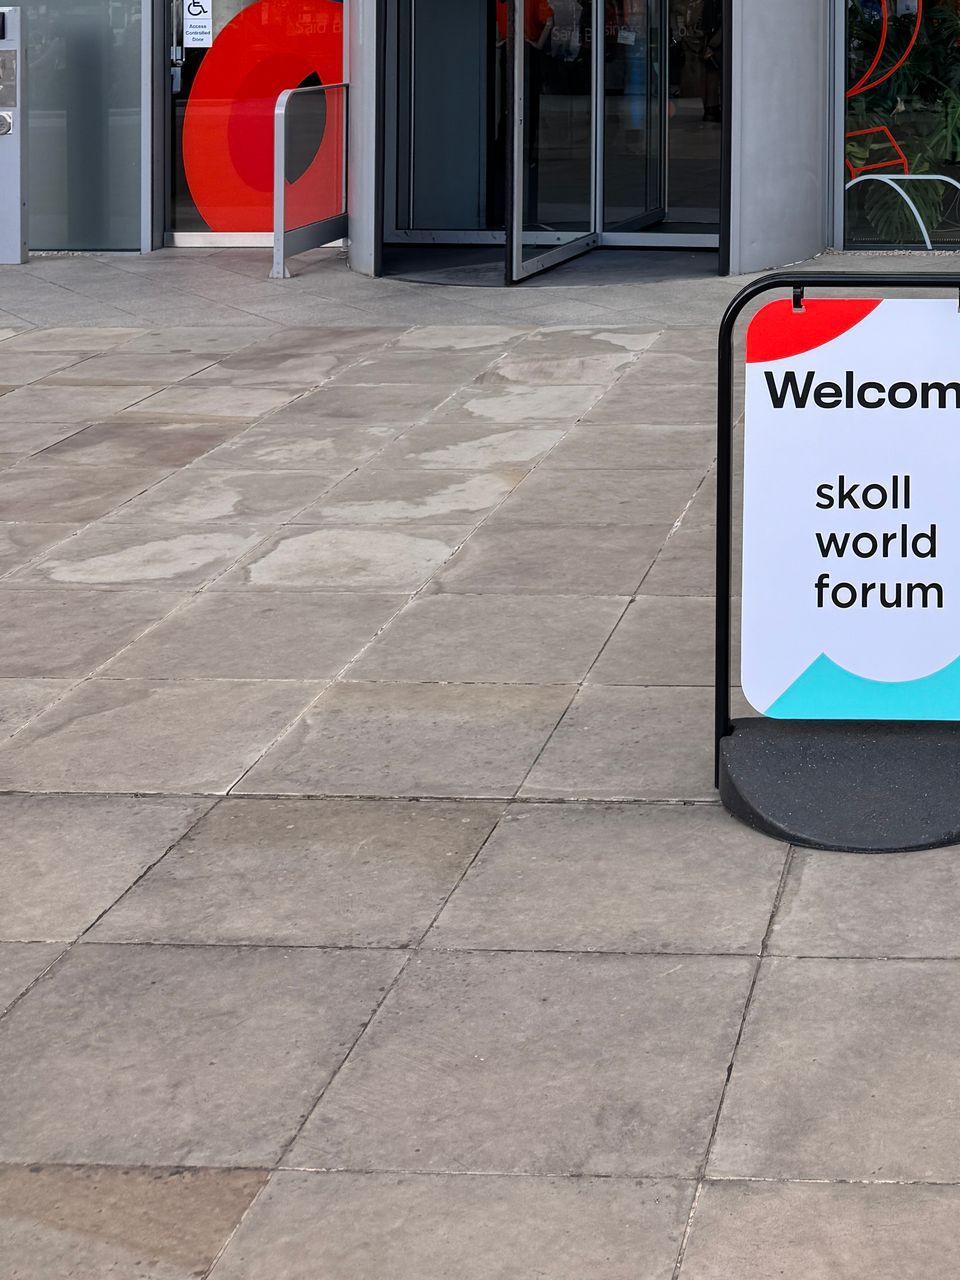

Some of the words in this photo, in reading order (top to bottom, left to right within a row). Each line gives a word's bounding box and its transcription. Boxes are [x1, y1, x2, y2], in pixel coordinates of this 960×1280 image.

[815, 474, 911, 511] skoll
[815, 524, 937, 559] world
[815, 573, 944, 609] forum
